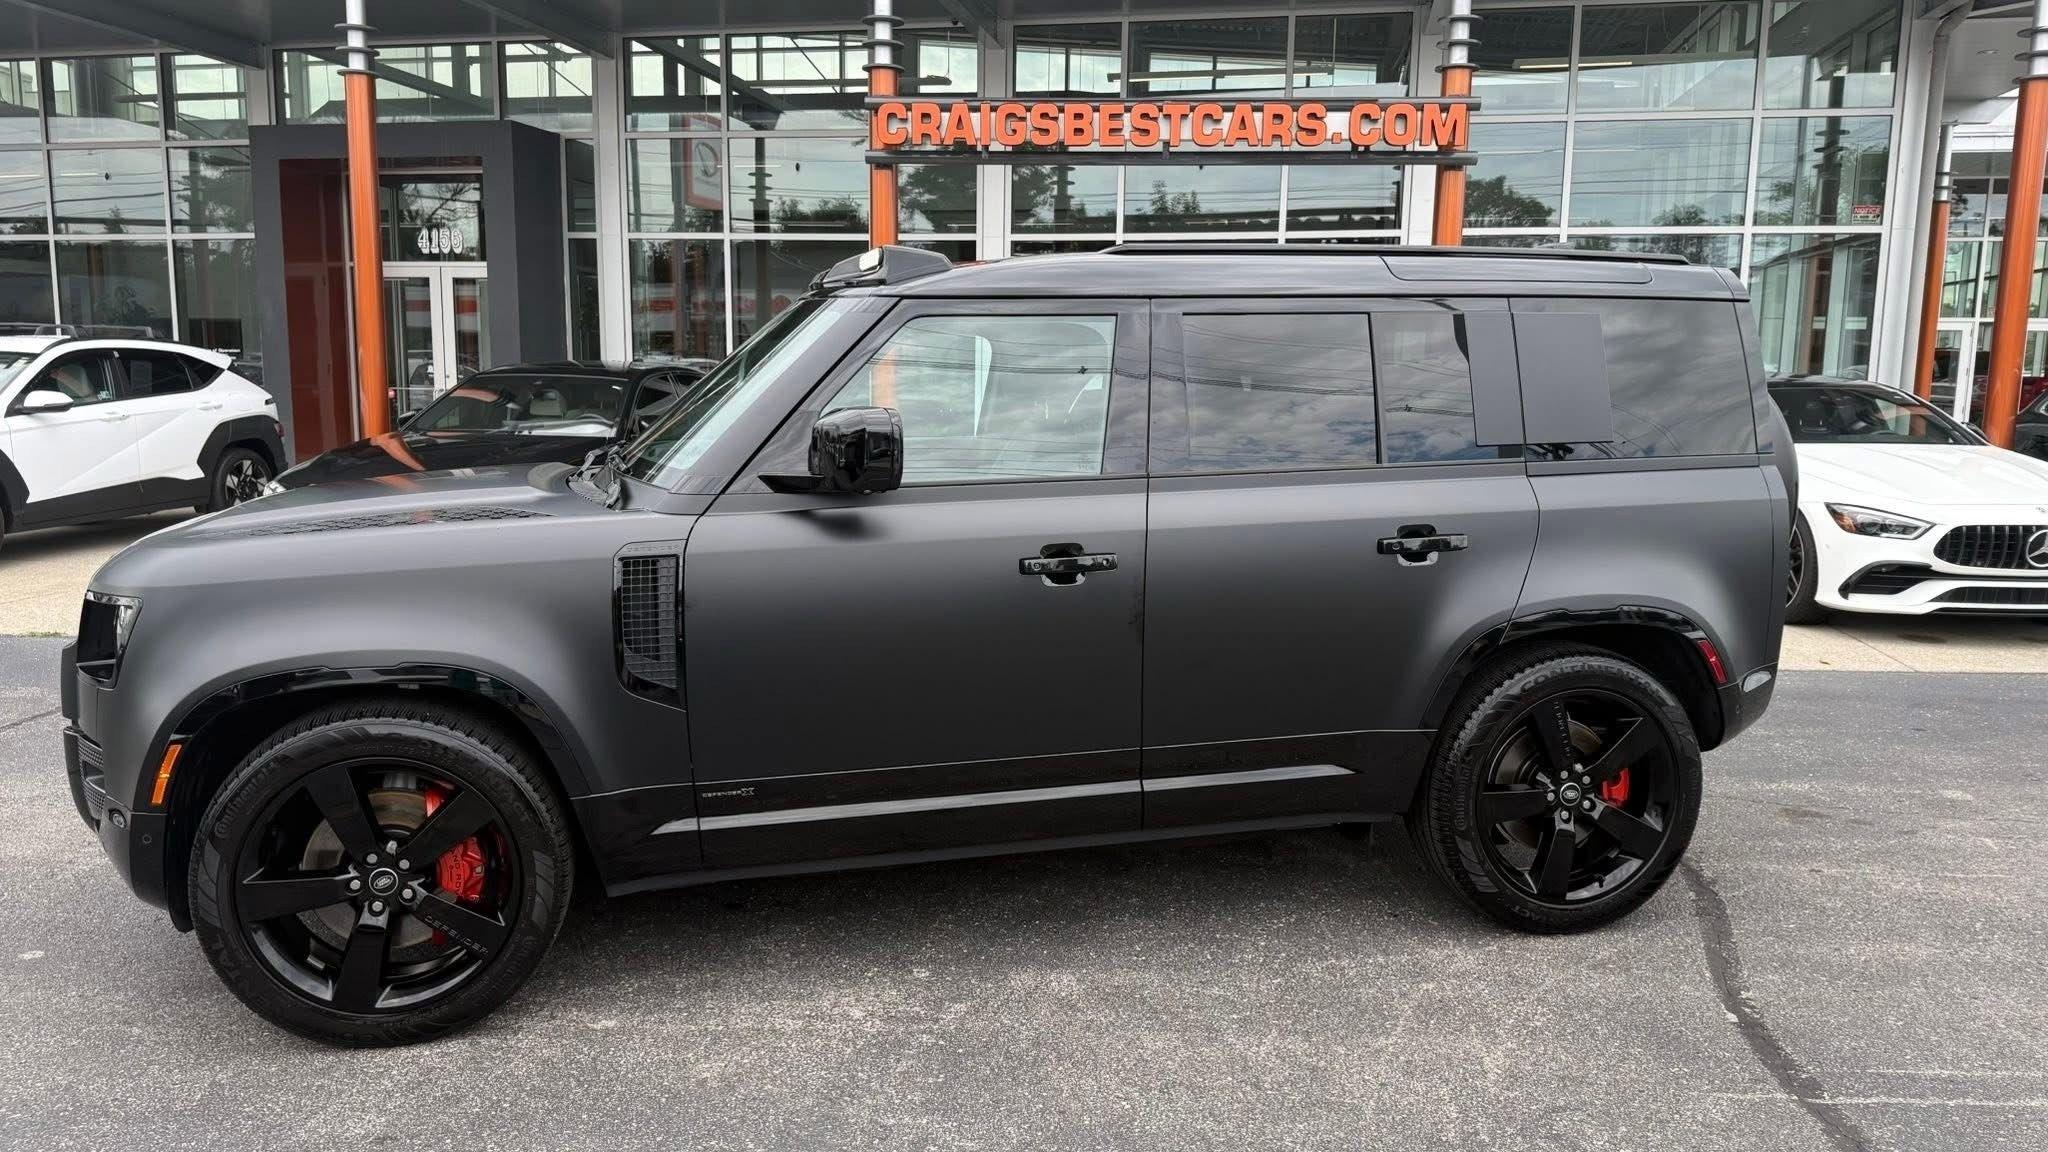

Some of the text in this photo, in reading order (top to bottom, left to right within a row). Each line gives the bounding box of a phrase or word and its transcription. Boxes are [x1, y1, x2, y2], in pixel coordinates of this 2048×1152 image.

[876, 102, 1467, 147] CRAIGSBESTCARS.COM
[417, 227, 463, 254] 4156
[424, 914, 490, 955] DEFENDER
